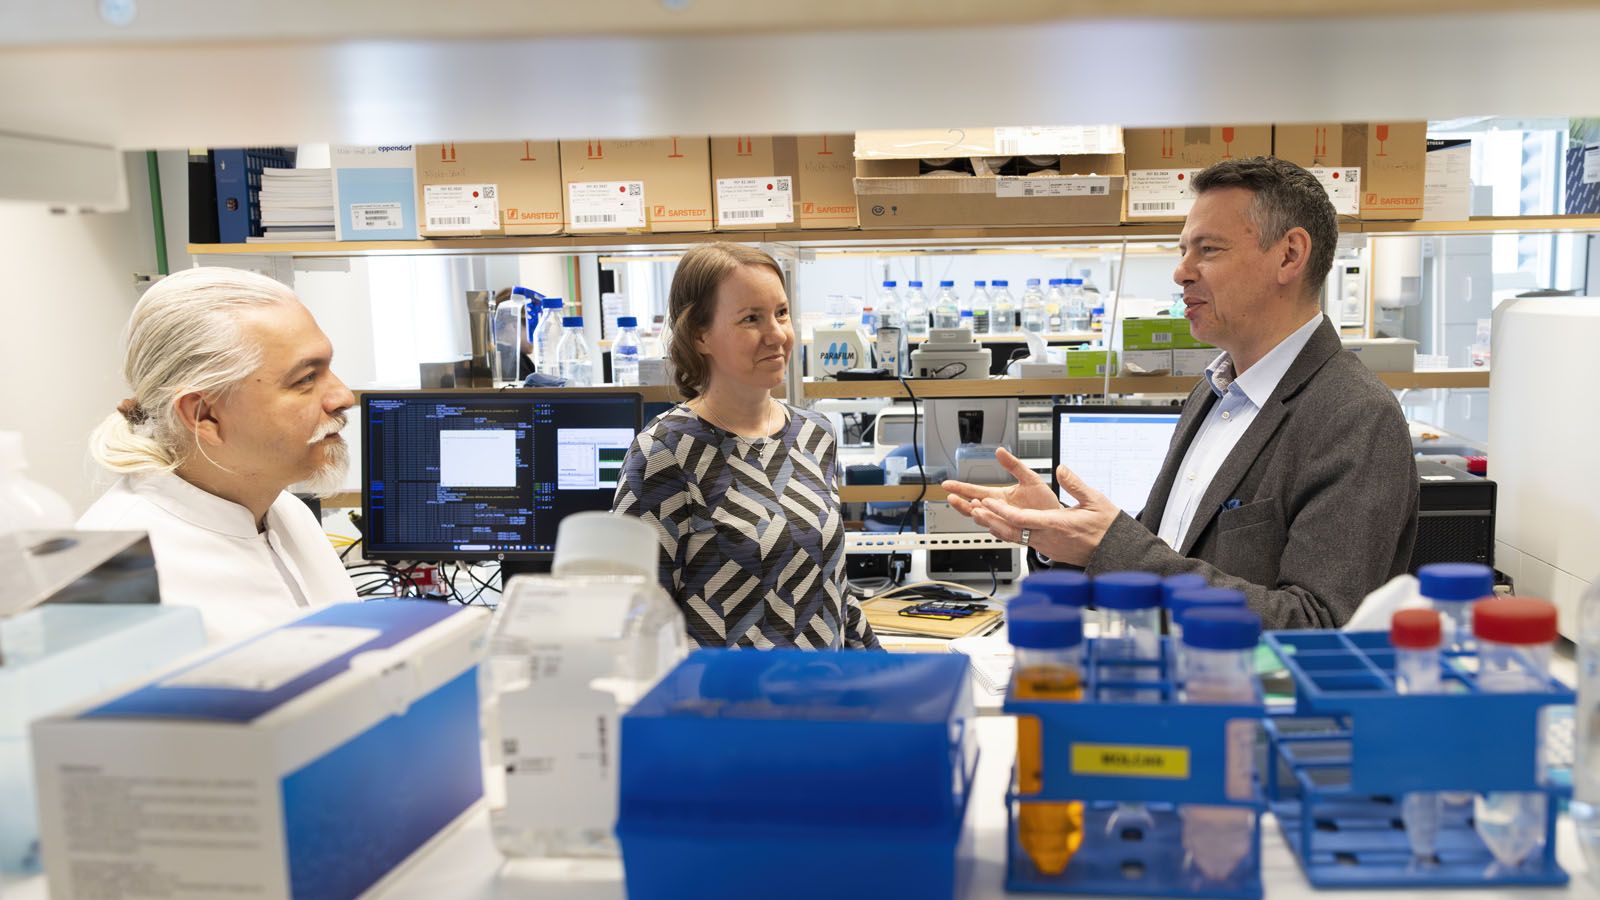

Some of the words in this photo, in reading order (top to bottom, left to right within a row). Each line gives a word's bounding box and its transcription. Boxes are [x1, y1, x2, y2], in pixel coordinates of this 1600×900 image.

[378, 144, 412, 152] eppendorf
[1380, 197, 1420, 205] SARSTEDT
[521, 212, 560, 220] SARSTEDT
[668, 209, 706, 217] SARSTEDT
[820, 352, 855, 360] PARAFILM
